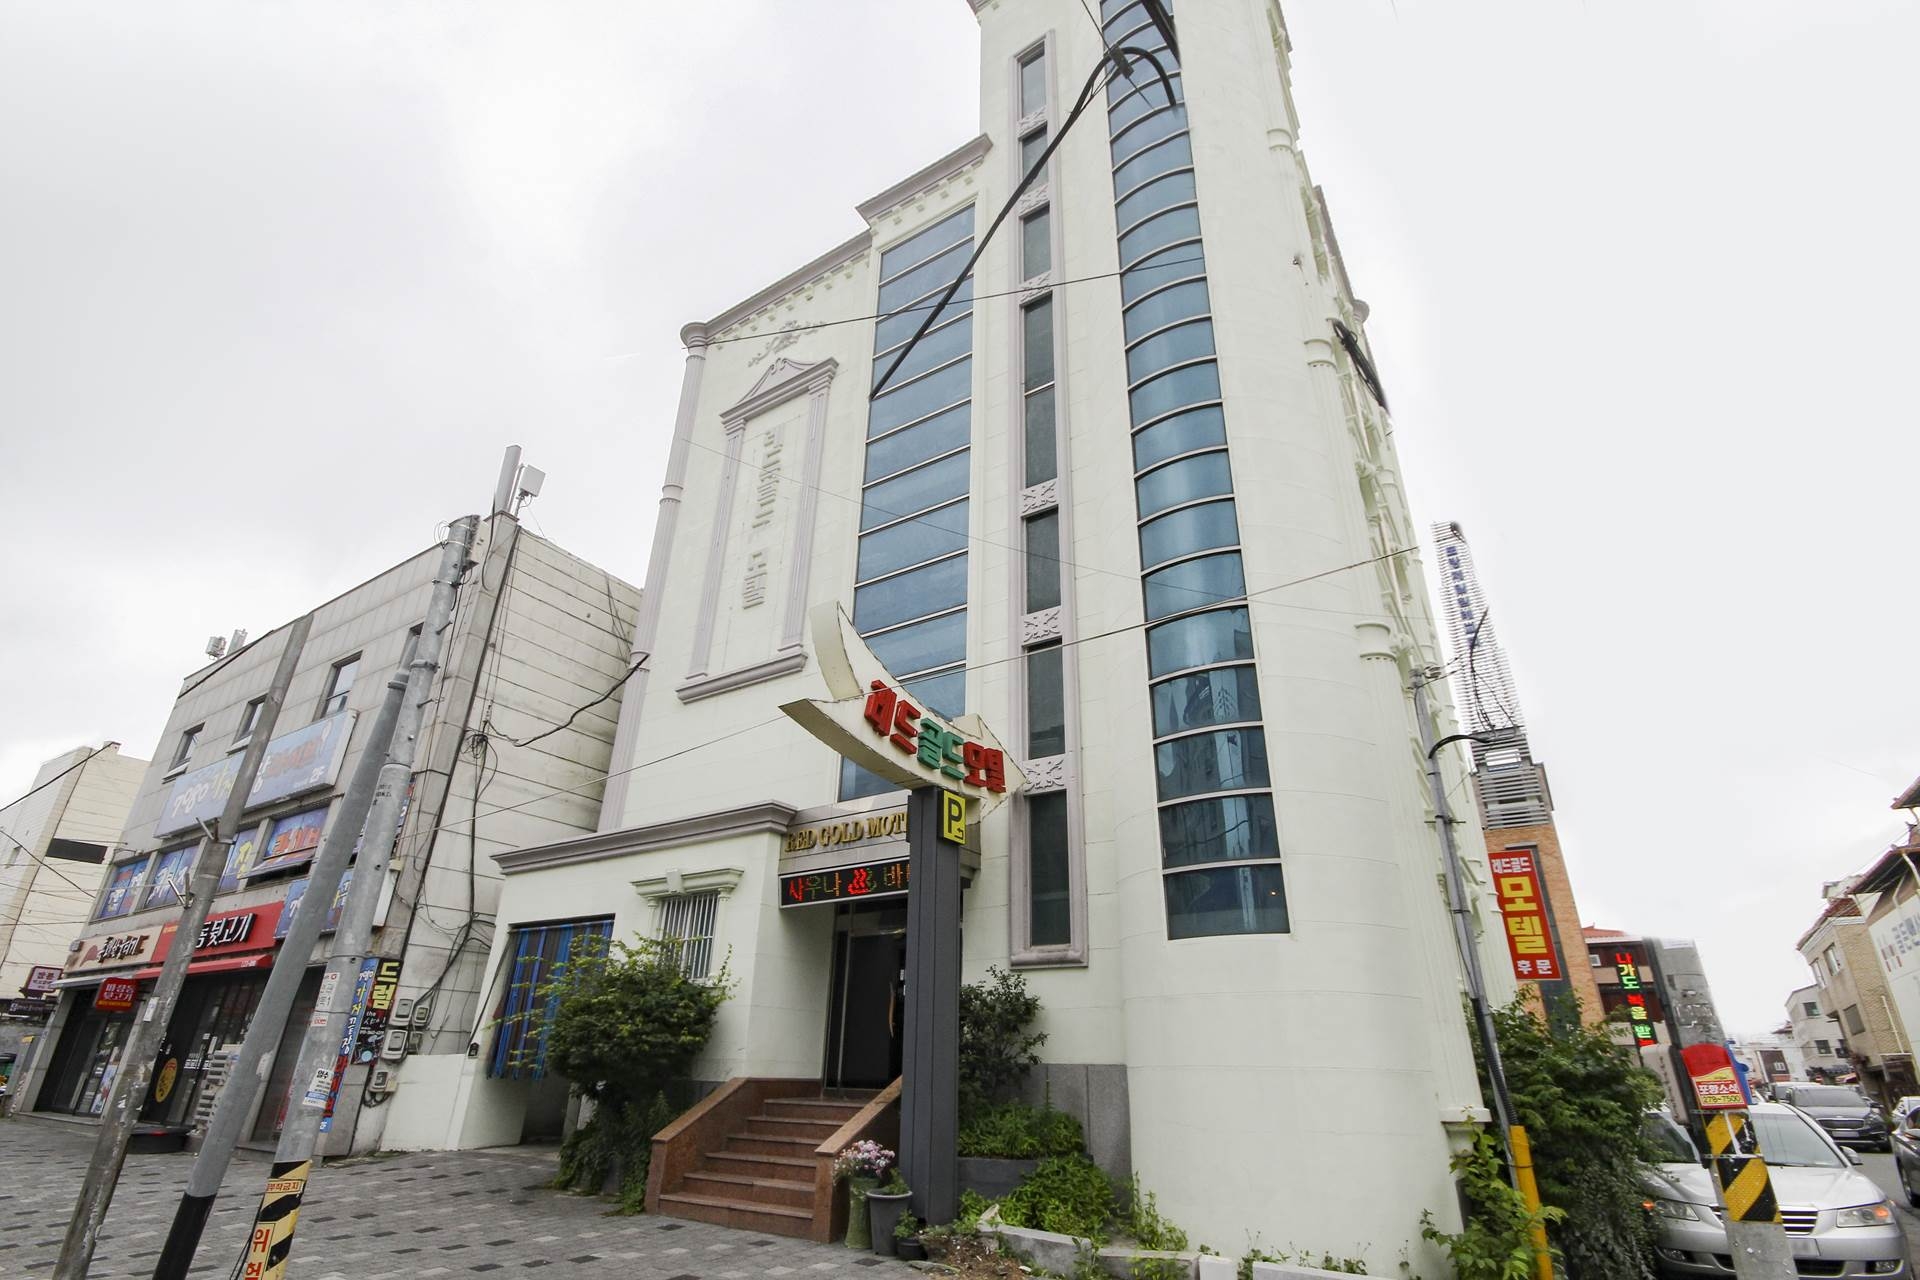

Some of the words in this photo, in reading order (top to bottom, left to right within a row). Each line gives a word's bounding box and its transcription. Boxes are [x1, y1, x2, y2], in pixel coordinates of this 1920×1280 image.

[949, 799, 964, 835] P
[785, 828, 817, 852] RED
[818, 821, 864, 848] GOLD
[1491, 857, 1532, 874] 레드골드
[789, 872, 841, 902] 사우나
[1500, 876, 1548, 954] 모텔
[372, 961, 400, 1010] 드럼
